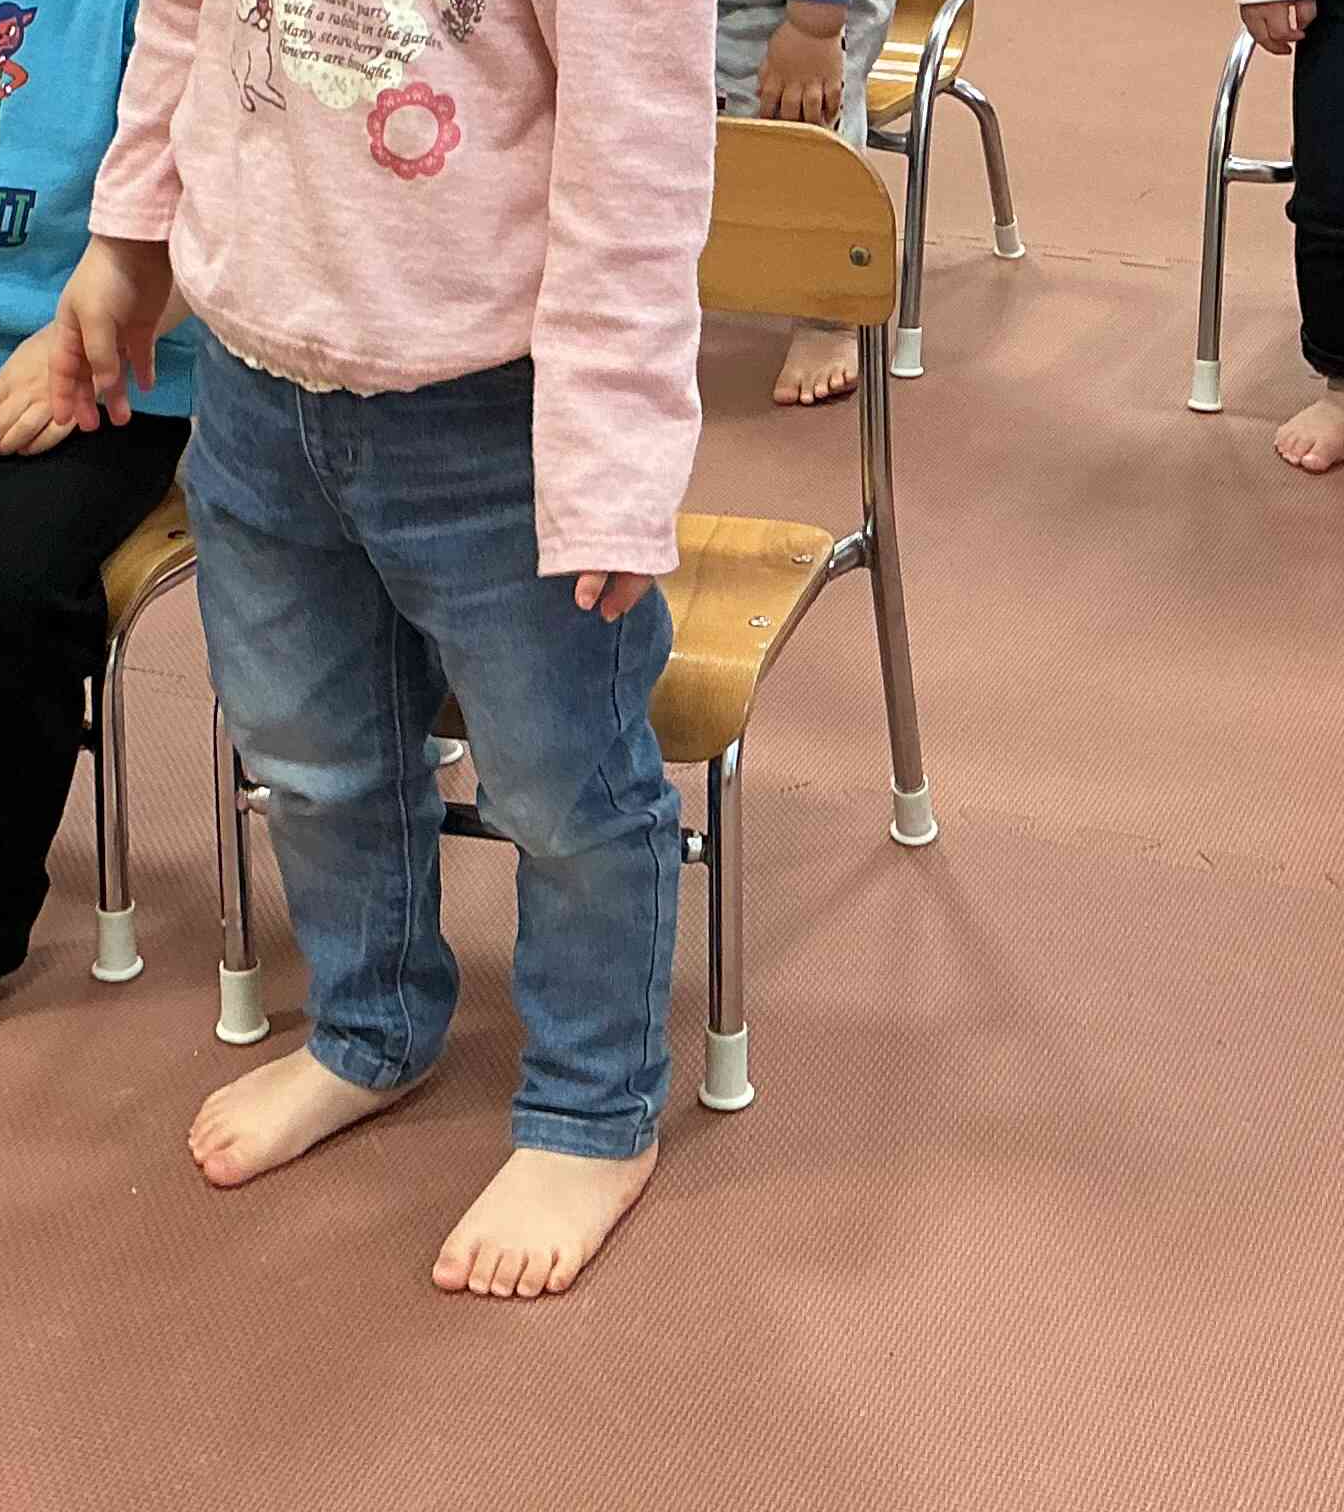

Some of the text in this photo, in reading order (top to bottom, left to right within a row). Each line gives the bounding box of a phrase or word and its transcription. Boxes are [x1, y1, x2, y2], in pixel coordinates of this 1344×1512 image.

[283, 1, 314, 19] with
[316, 10, 324, 22] a
[361, 22, 374, 38] in
[376, 23, 401, 42] the
[357, 2, 391, 21] party
[278, 37, 321, 62] flowers
[323, 53, 347, 66] are
[279, 19, 412, 63] Many strawberry and
